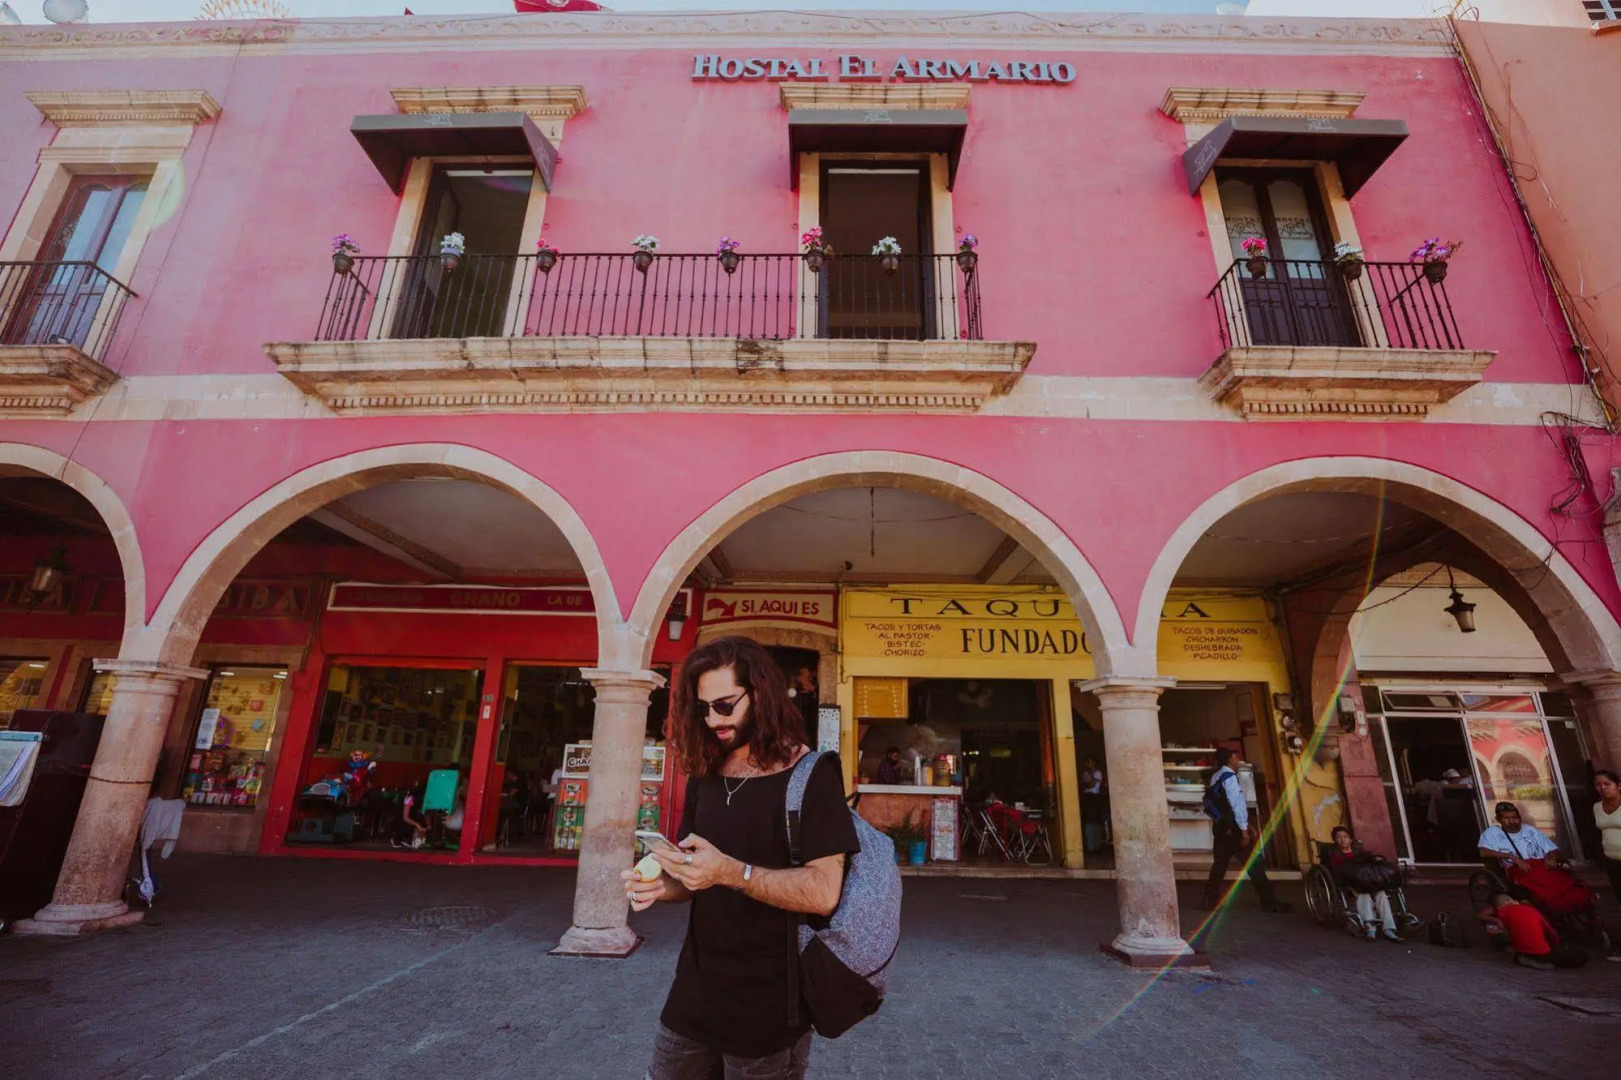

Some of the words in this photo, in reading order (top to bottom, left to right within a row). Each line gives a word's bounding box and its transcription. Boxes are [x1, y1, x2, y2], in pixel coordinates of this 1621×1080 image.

[692, 54, 829, 82] HOSTAL
[838, 54, 882, 82] EL
[889, 54, 1077, 87] ARMARIO
[759, 599, 798, 615] AQUI
[801, 602, 820, 616] ES
[864, 623, 895, 631] TACOS
[898, 623, 905, 631] Y
[906, 623, 942, 631] TORTAS
[1172, 626, 1202, 635] TACOS
[1205, 626, 1215, 635] DE
[1217, 627, 1259, 635] GUISADOS
[878, 632, 891, 640] AL
[893, 632, 930, 640] PASTOR
[887, 640, 922, 648] BISTEC
[1183, 643, 1243, 653] DESHEBRADA
[884, 648, 925, 657] CHORIZO
[1193, 652, 1239, 661] PICADILLO
